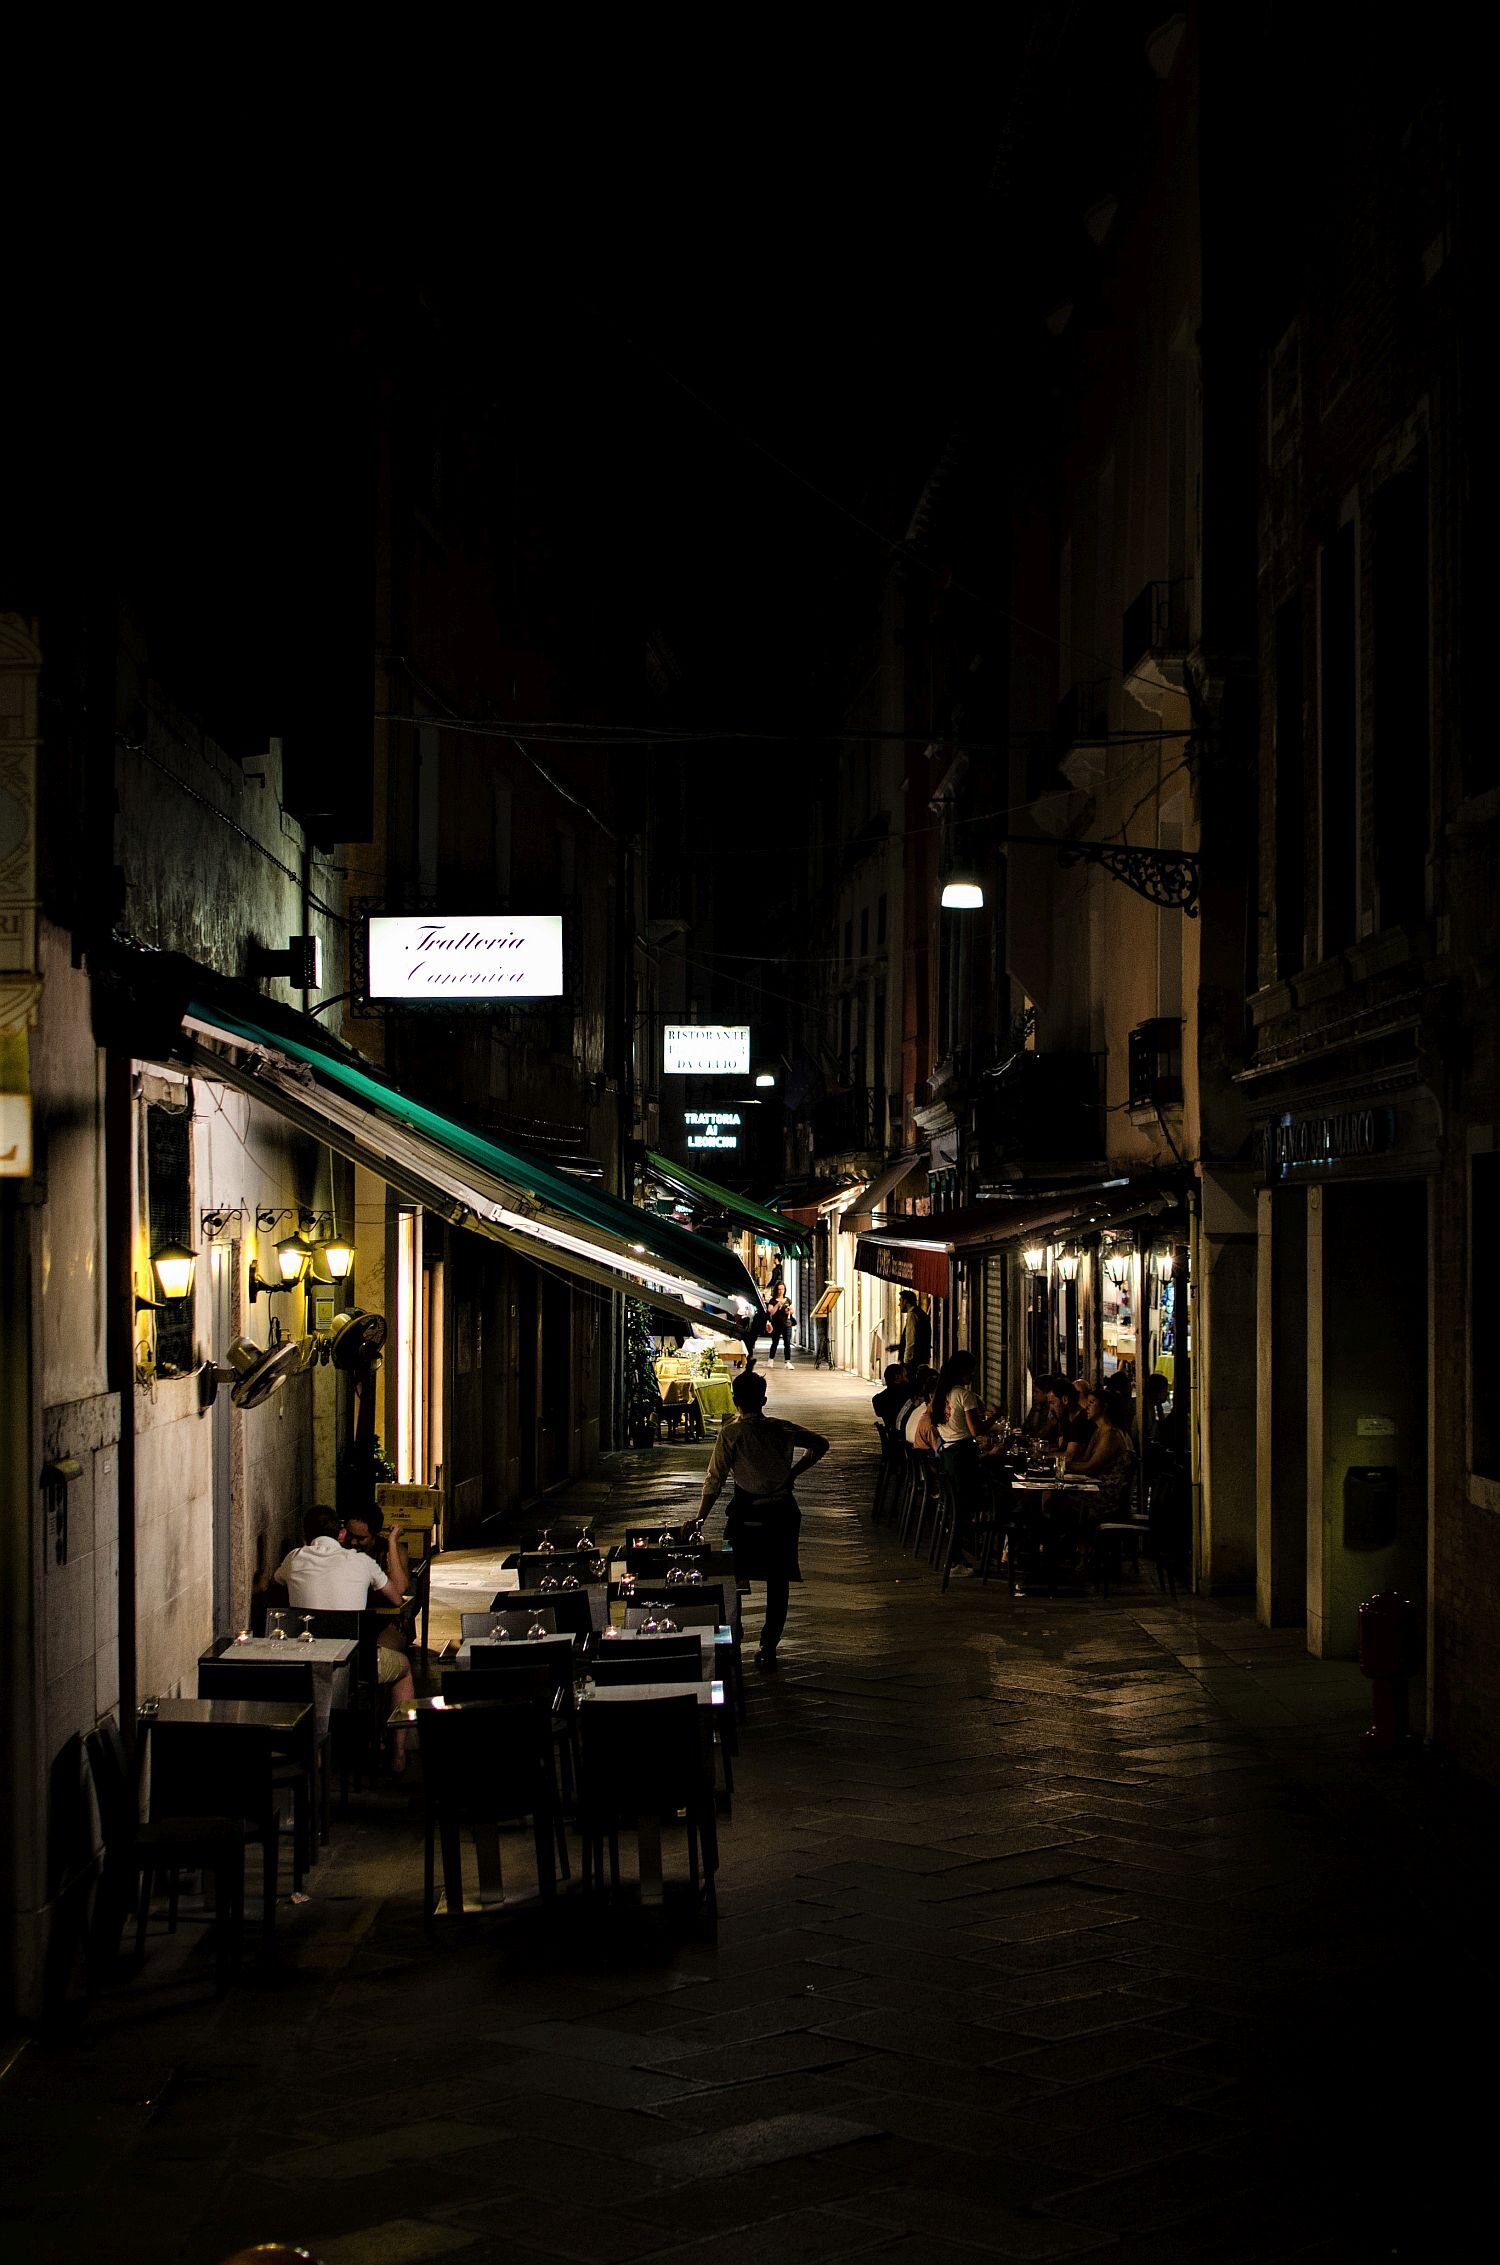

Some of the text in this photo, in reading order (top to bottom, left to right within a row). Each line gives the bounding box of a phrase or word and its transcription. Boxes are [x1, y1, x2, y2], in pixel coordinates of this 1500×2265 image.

[405, 925, 526, 951] Trattoria
[668, 1030, 747, 1041] RISTORANTE
[684, 1113, 741, 1125] TRATTORIA
[705, 1124, 718, 1136] AI
[1334, 1109, 1375, 1154] MARCO
